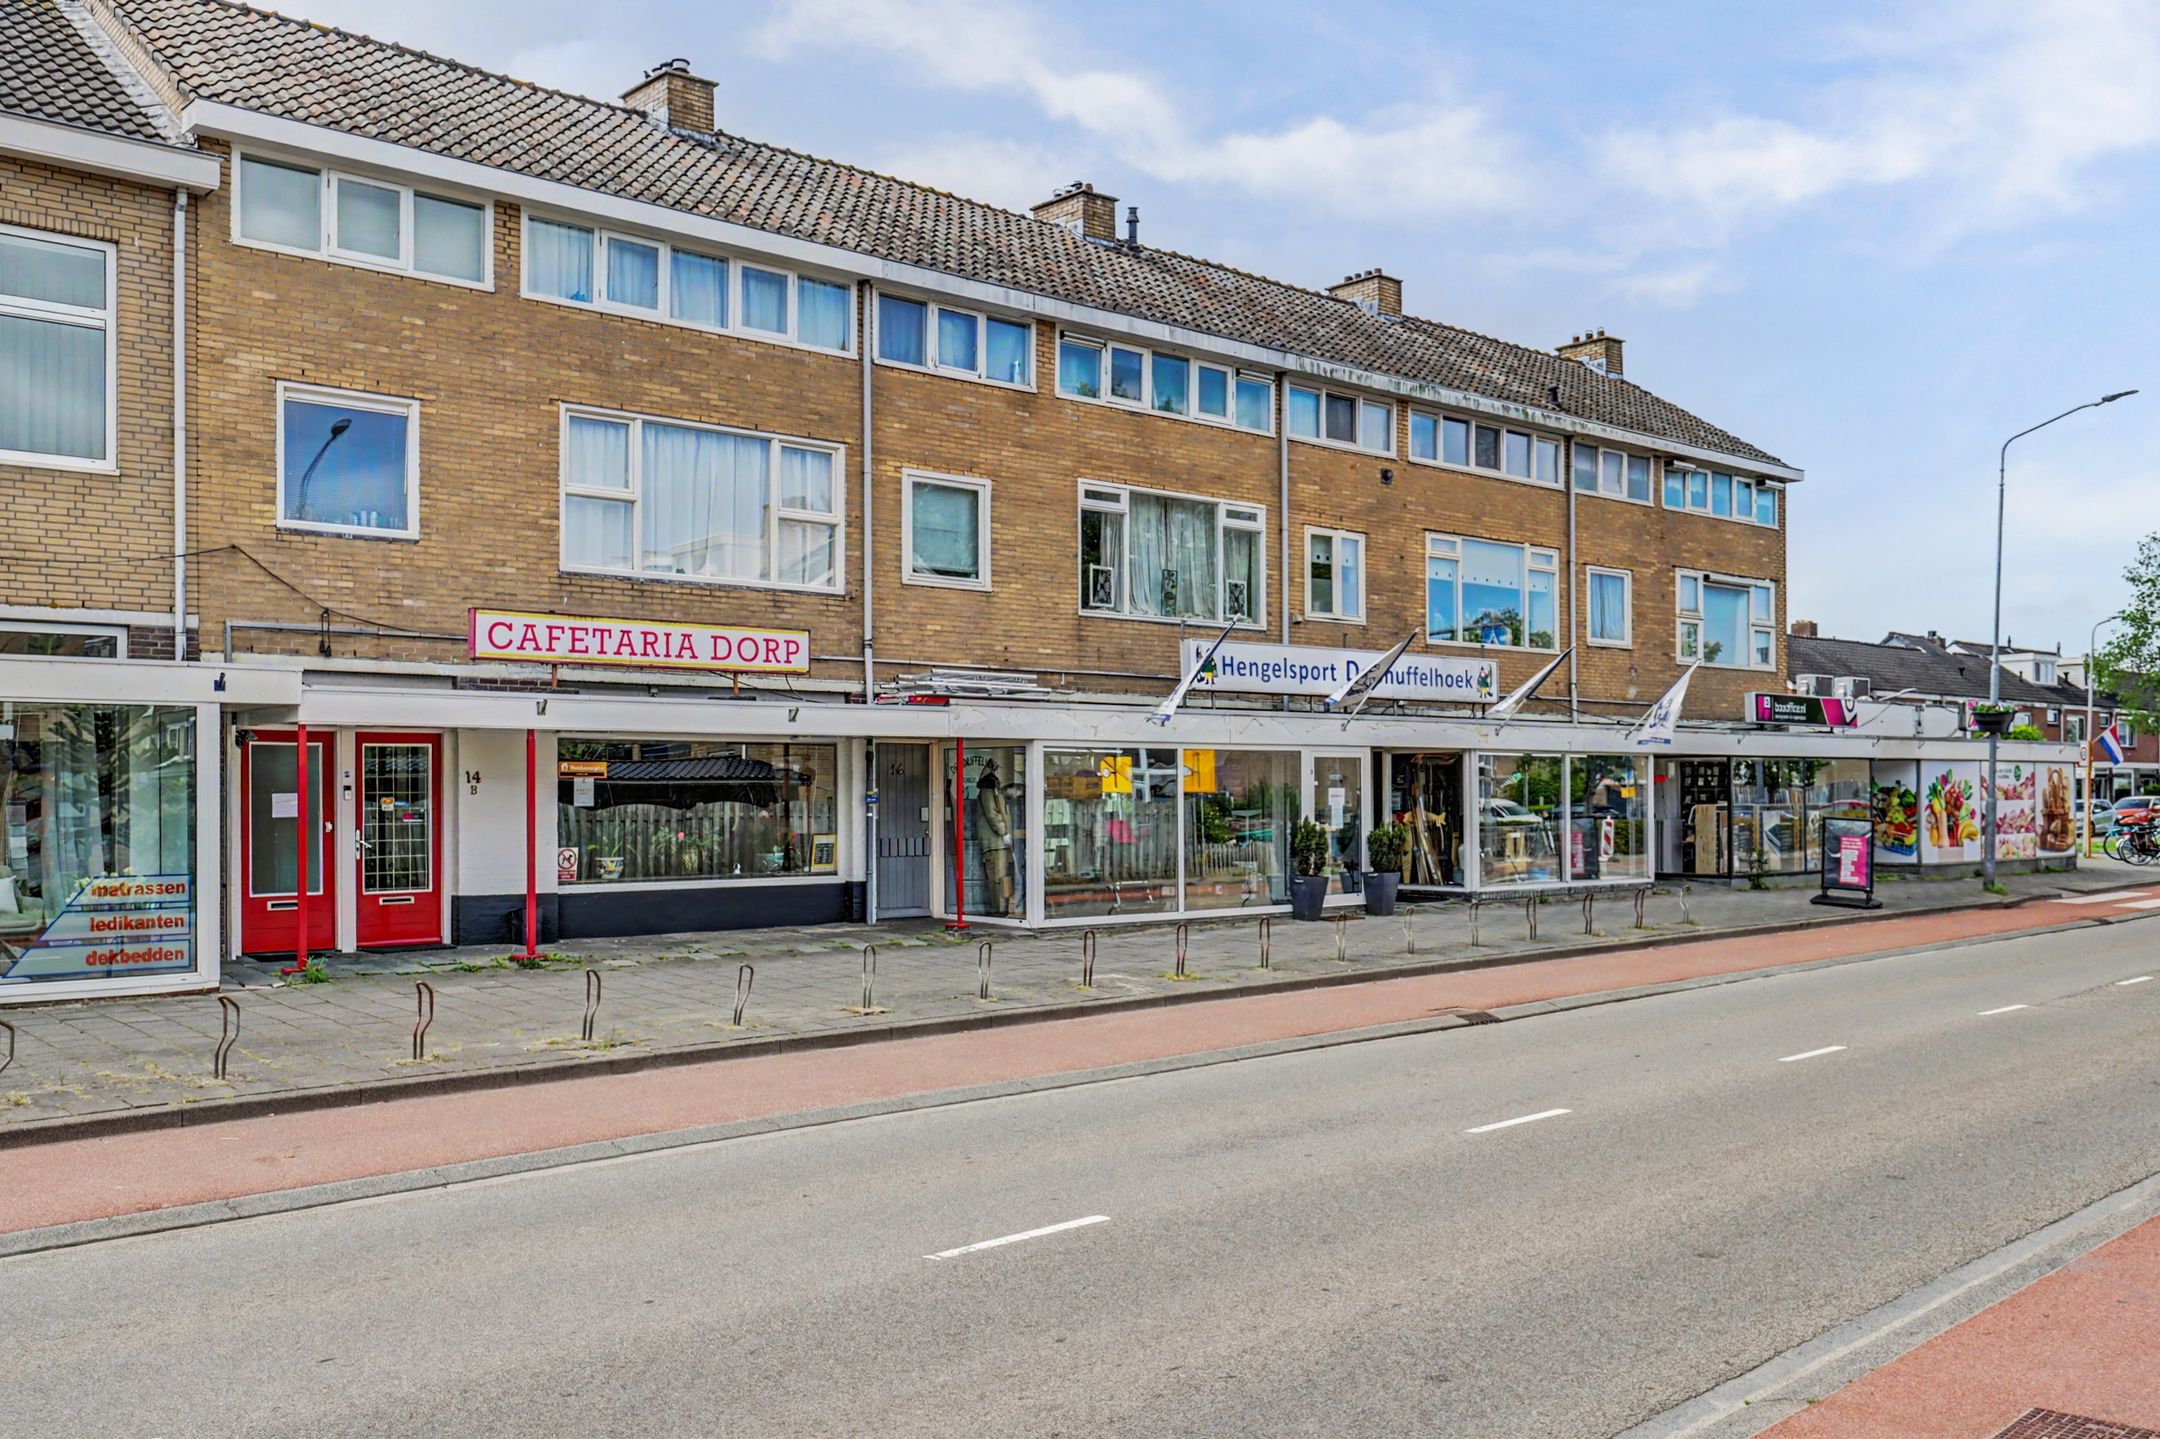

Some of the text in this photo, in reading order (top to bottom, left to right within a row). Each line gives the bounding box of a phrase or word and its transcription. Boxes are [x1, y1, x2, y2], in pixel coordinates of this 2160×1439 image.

[487, 621, 800, 664] CAFETARIA DORP
[1222, 655, 1337, 684] Hengelsport
[1377, 664, 1473, 689] nuffelhoek
[465, 770, 482, 784] 14
[890, 763, 905, 776] 16
[470, 785, 478, 796] B
[91, 882, 186, 897] matrassen
[90, 914, 185, 933] ledikanten
[85, 947, 185, 967] dekbedden
